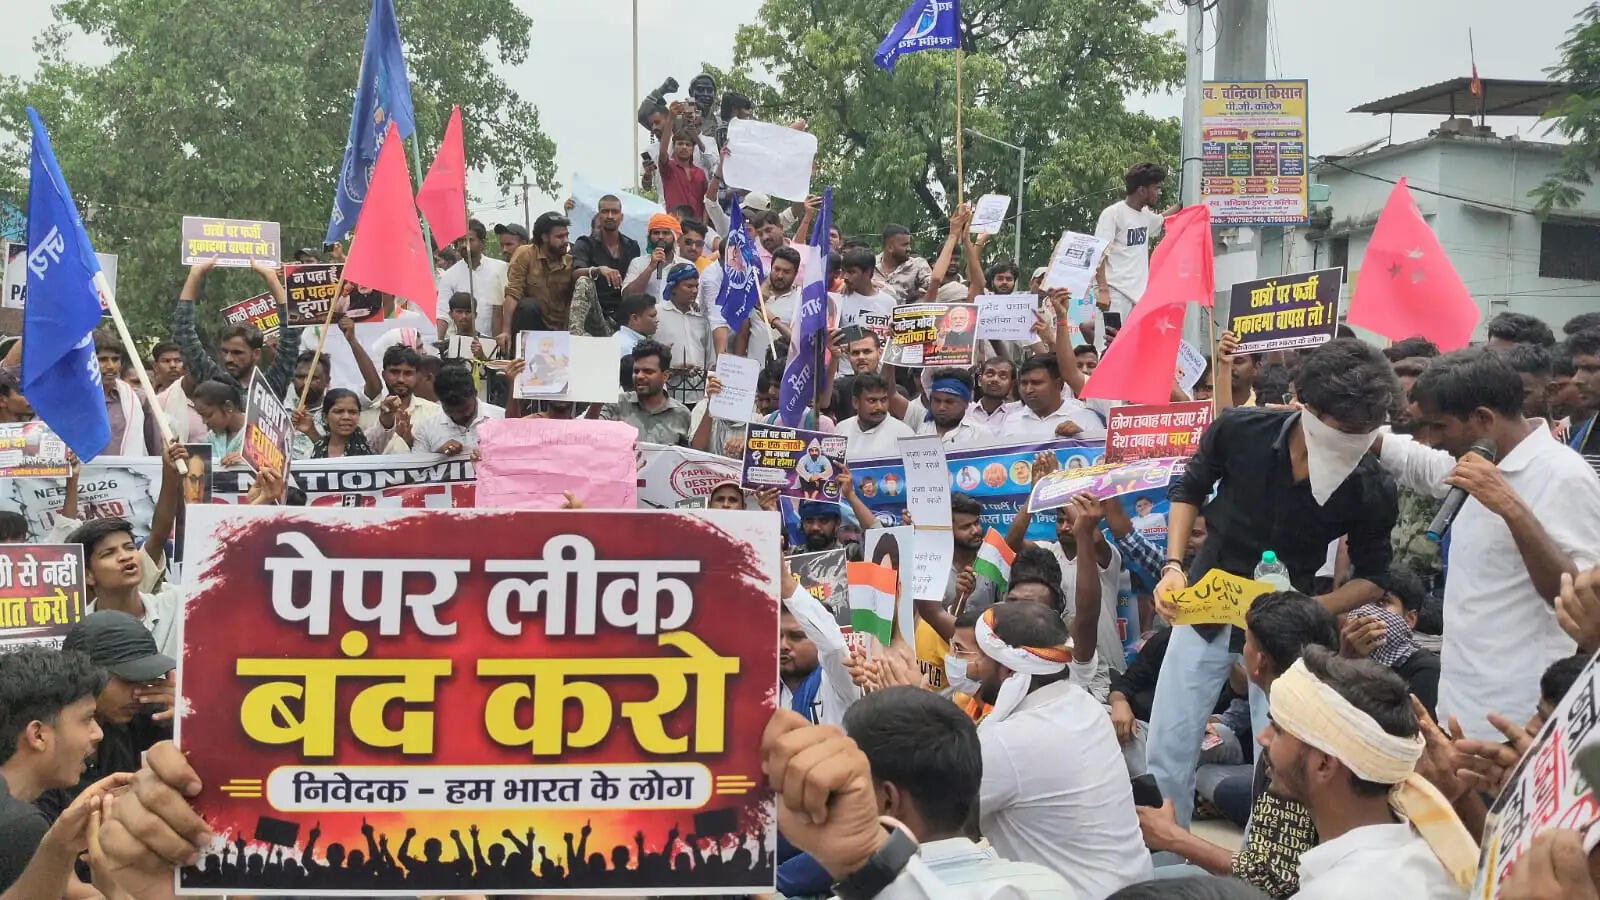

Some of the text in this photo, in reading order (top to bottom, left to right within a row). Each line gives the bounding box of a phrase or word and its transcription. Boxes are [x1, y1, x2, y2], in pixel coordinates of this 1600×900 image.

[290, 286, 304, 300] न
[292, 272, 304, 284] न
[1251, 274, 1319, 308] छात्रों पर फर्जी
[1276, 308, 1306, 330] वापस
[1307, 301, 1325, 327] लो
[253, 381, 287, 432] FIGHT
[1110, 413, 1133, 430] लोग
[1197, 406, 1208, 425] में
[251, 424, 285, 476] FUTURE
[1112, 433, 1129, 450] देश
[1169, 430, 1191, 445] चाय
[34, 479, 118, 499] NEE 2026
[16, 552, 78, 587] से नहीं
[265, 532, 700, 637] पेपर लीक
[30, 587, 69, 625] करो
[73, 591, 80, 624] !
[236, 631, 740, 757] बंद करो
[292, 772, 409, 805] निवेदक
[446, 774, 493, 804] हम
[504, 774, 581, 804] भारत
[590, 770, 620, 801] के
[628, 768, 694, 801] लोग
